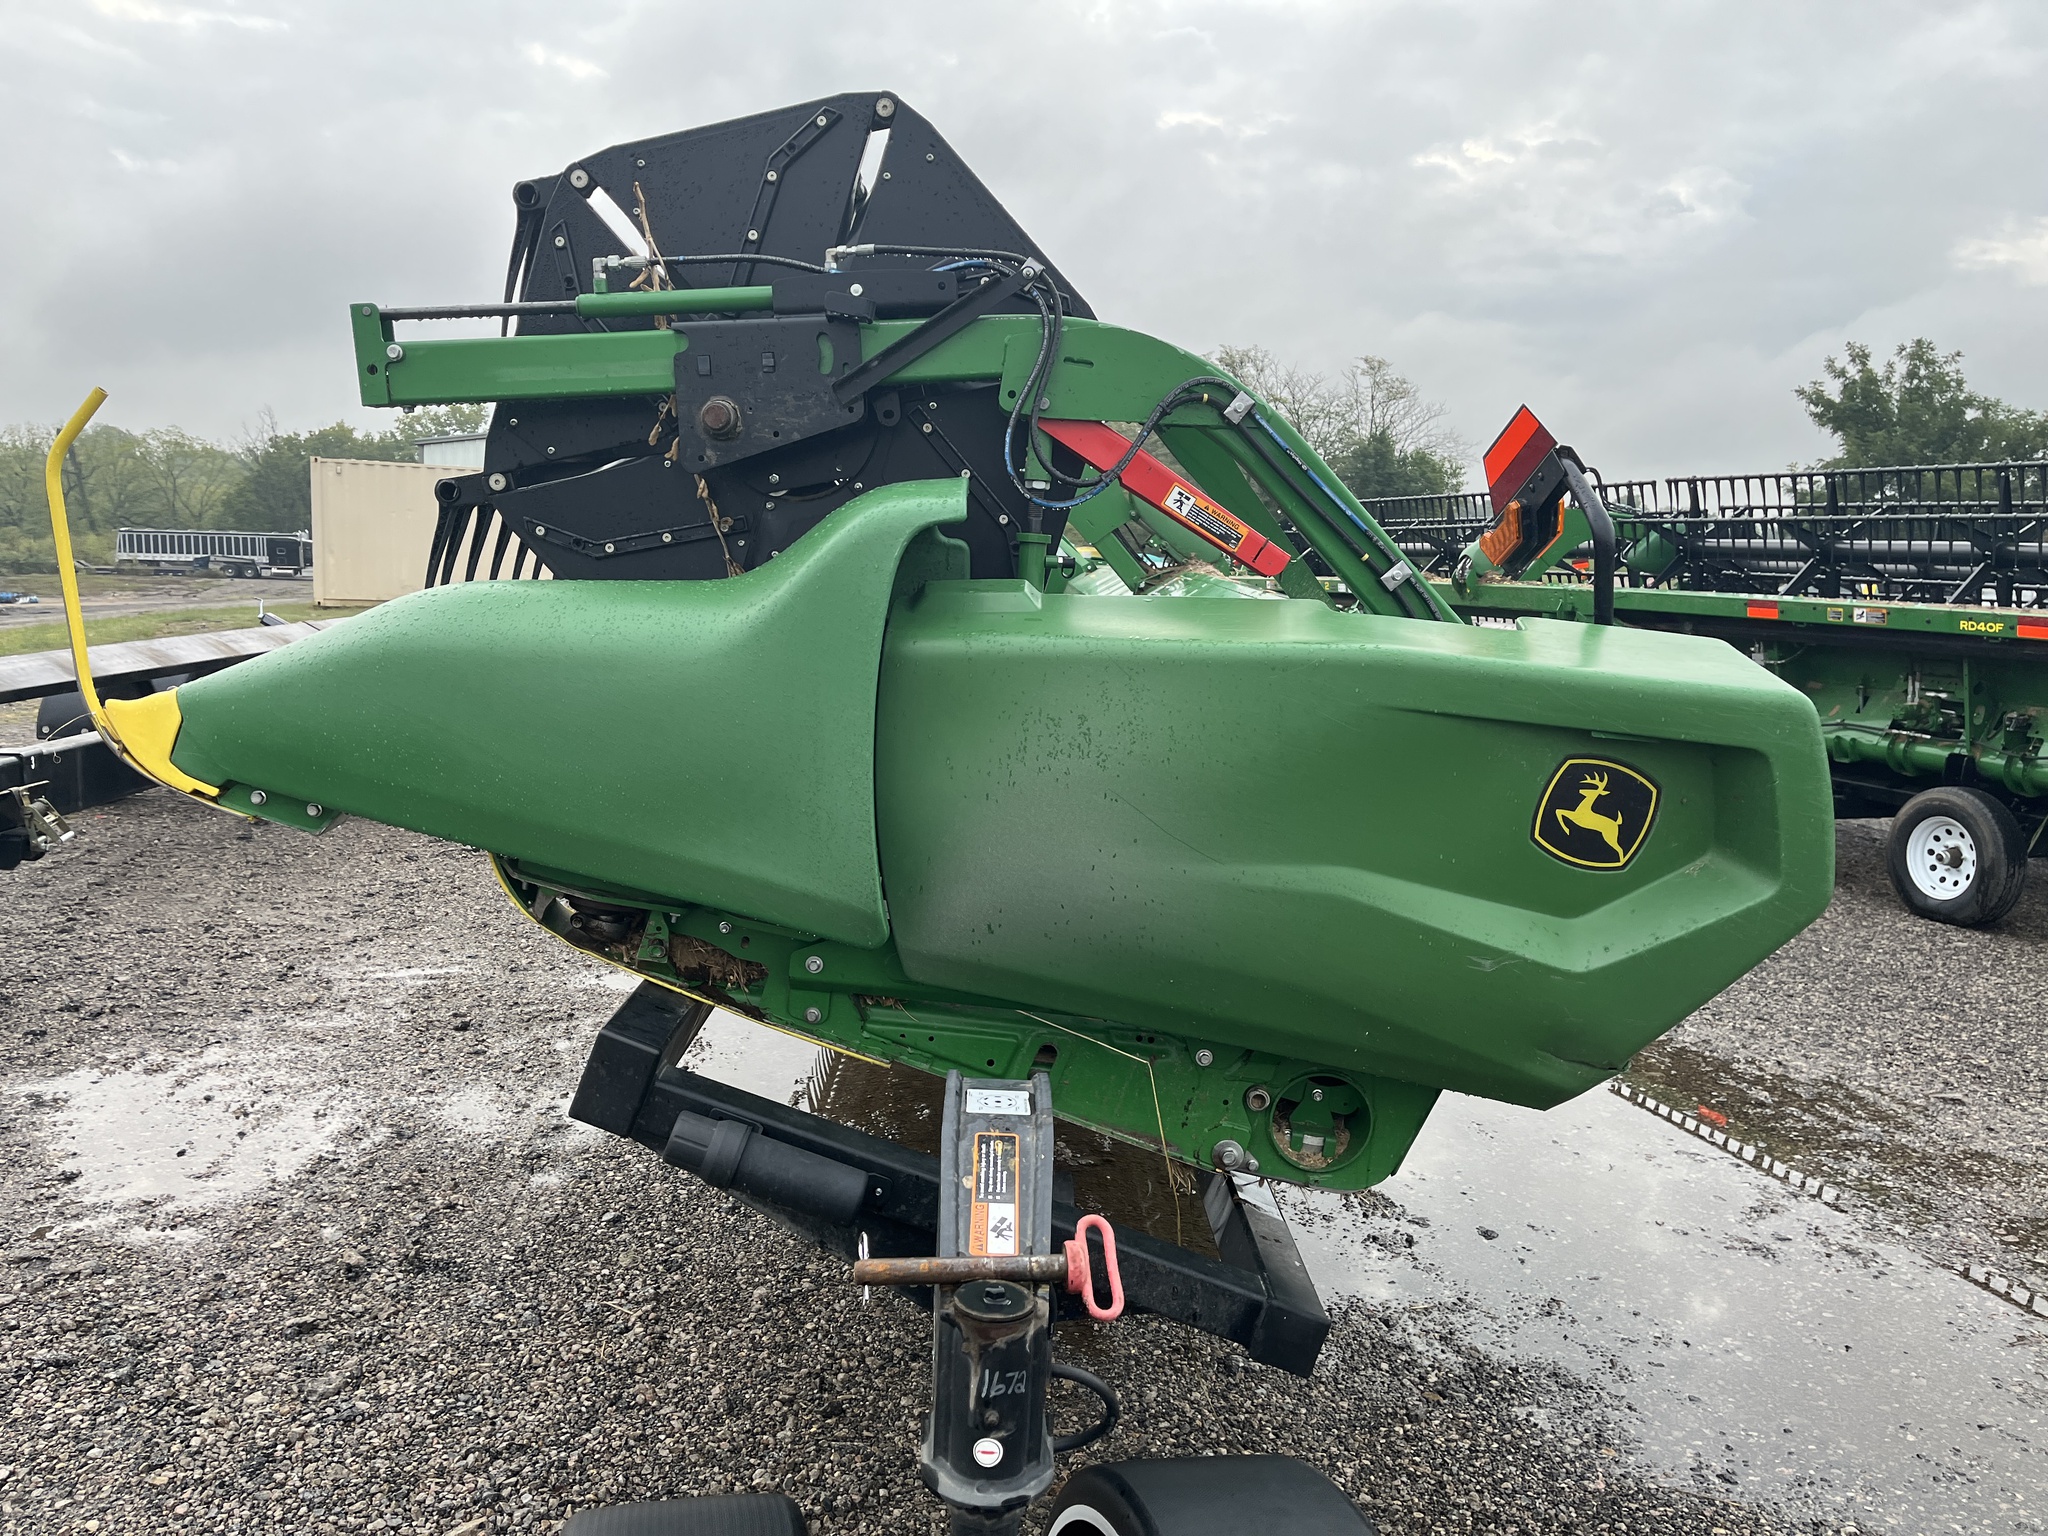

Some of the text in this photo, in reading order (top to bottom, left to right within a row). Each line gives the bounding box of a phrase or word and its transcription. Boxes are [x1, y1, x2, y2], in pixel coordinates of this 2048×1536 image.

[1211, 508, 1240, 530] WARNING
[974, 1204, 984, 1244] WARNING
[981, 1369, 1027, 1398] 1672
